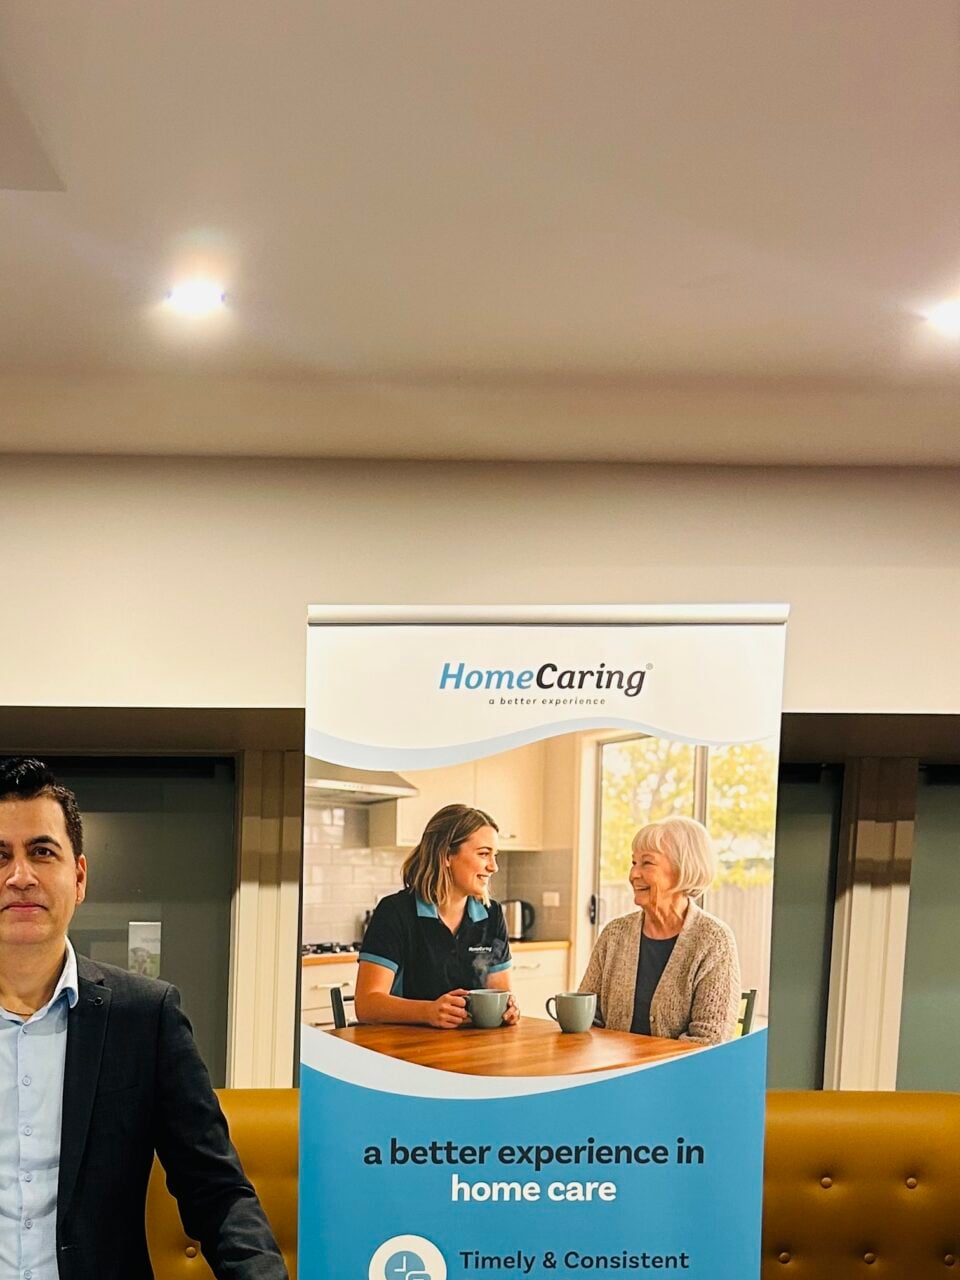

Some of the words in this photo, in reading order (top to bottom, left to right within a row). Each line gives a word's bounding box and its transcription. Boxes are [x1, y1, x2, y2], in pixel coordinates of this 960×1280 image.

[501, 697, 537, 705] better
[542, 697, 605, 707] experience
[363, 1145, 382, 1164] a
[391, 1137, 491, 1164] better
[498, 1137, 669, 1171] experience
[677, 1137, 704, 1164] in
[451, 1173, 540, 1201] home
[547, 1180, 616, 1201] care
[459, 1251, 535, 1273] Timely
[543, 1252, 557, 1269] &
[564, 1251, 689, 1269] Consistent
